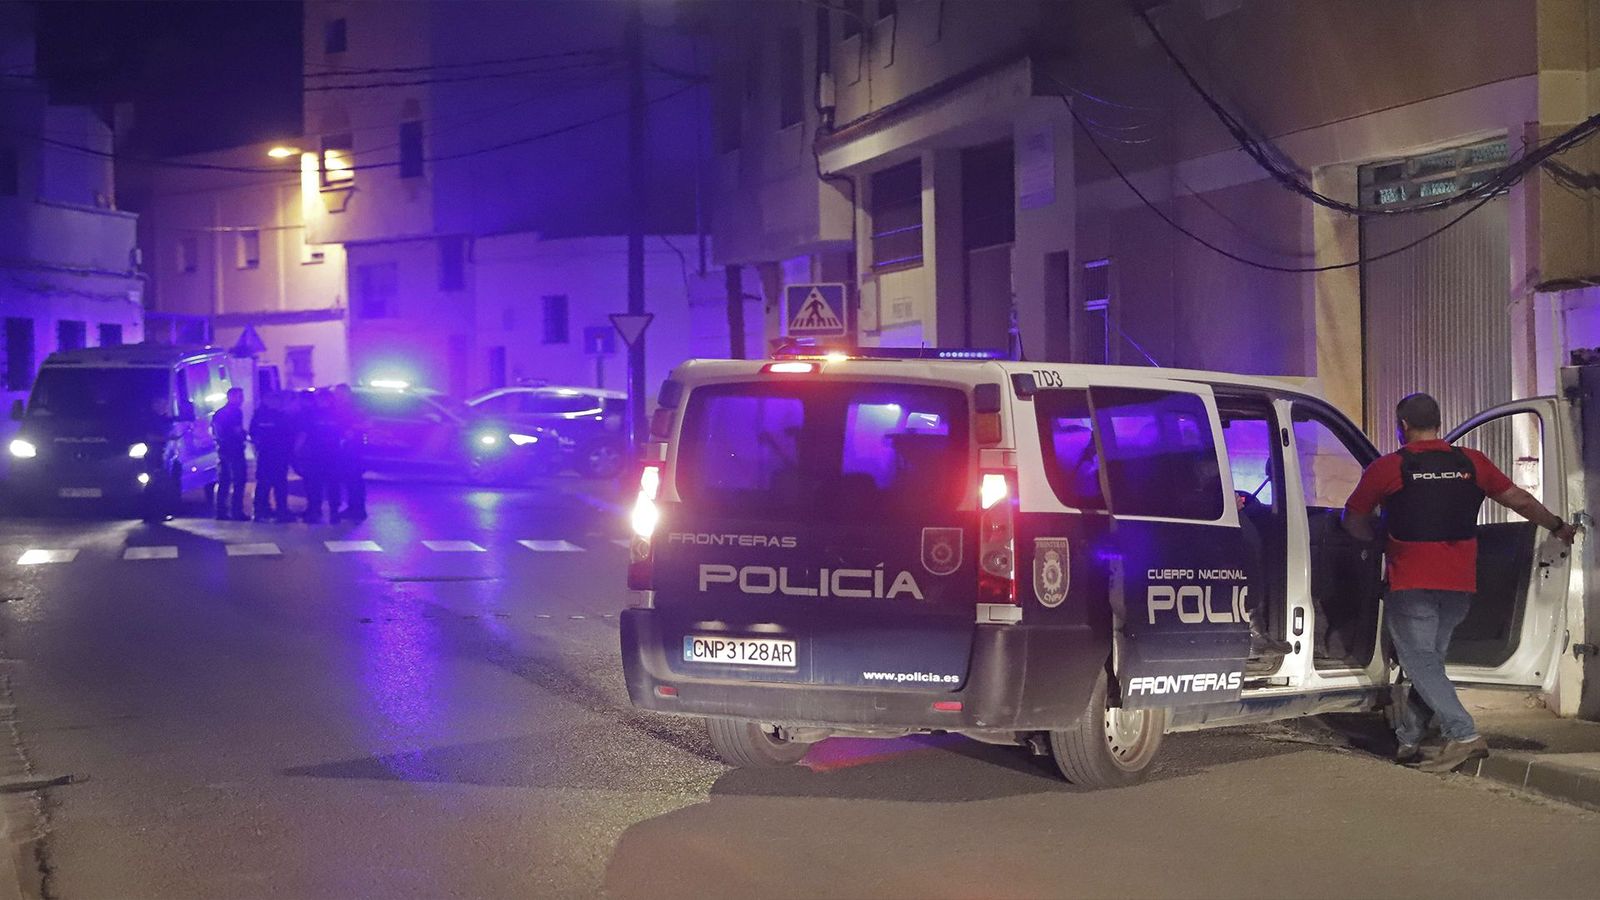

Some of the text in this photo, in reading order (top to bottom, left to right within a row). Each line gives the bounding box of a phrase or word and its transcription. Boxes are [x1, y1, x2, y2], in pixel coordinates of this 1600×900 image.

[1032, 369, 1063, 388] 7D3
[1412, 471, 1463, 480] POLICIA
[668, 532, 797, 548] FRONTERAS
[699, 562, 924, 600] POLICÍA
[1147, 569, 1247, 580] CUERPO NACIONAL
[863, 671, 959, 683] www.policia.es
[1127, 671, 1242, 696] FRONTERAS
